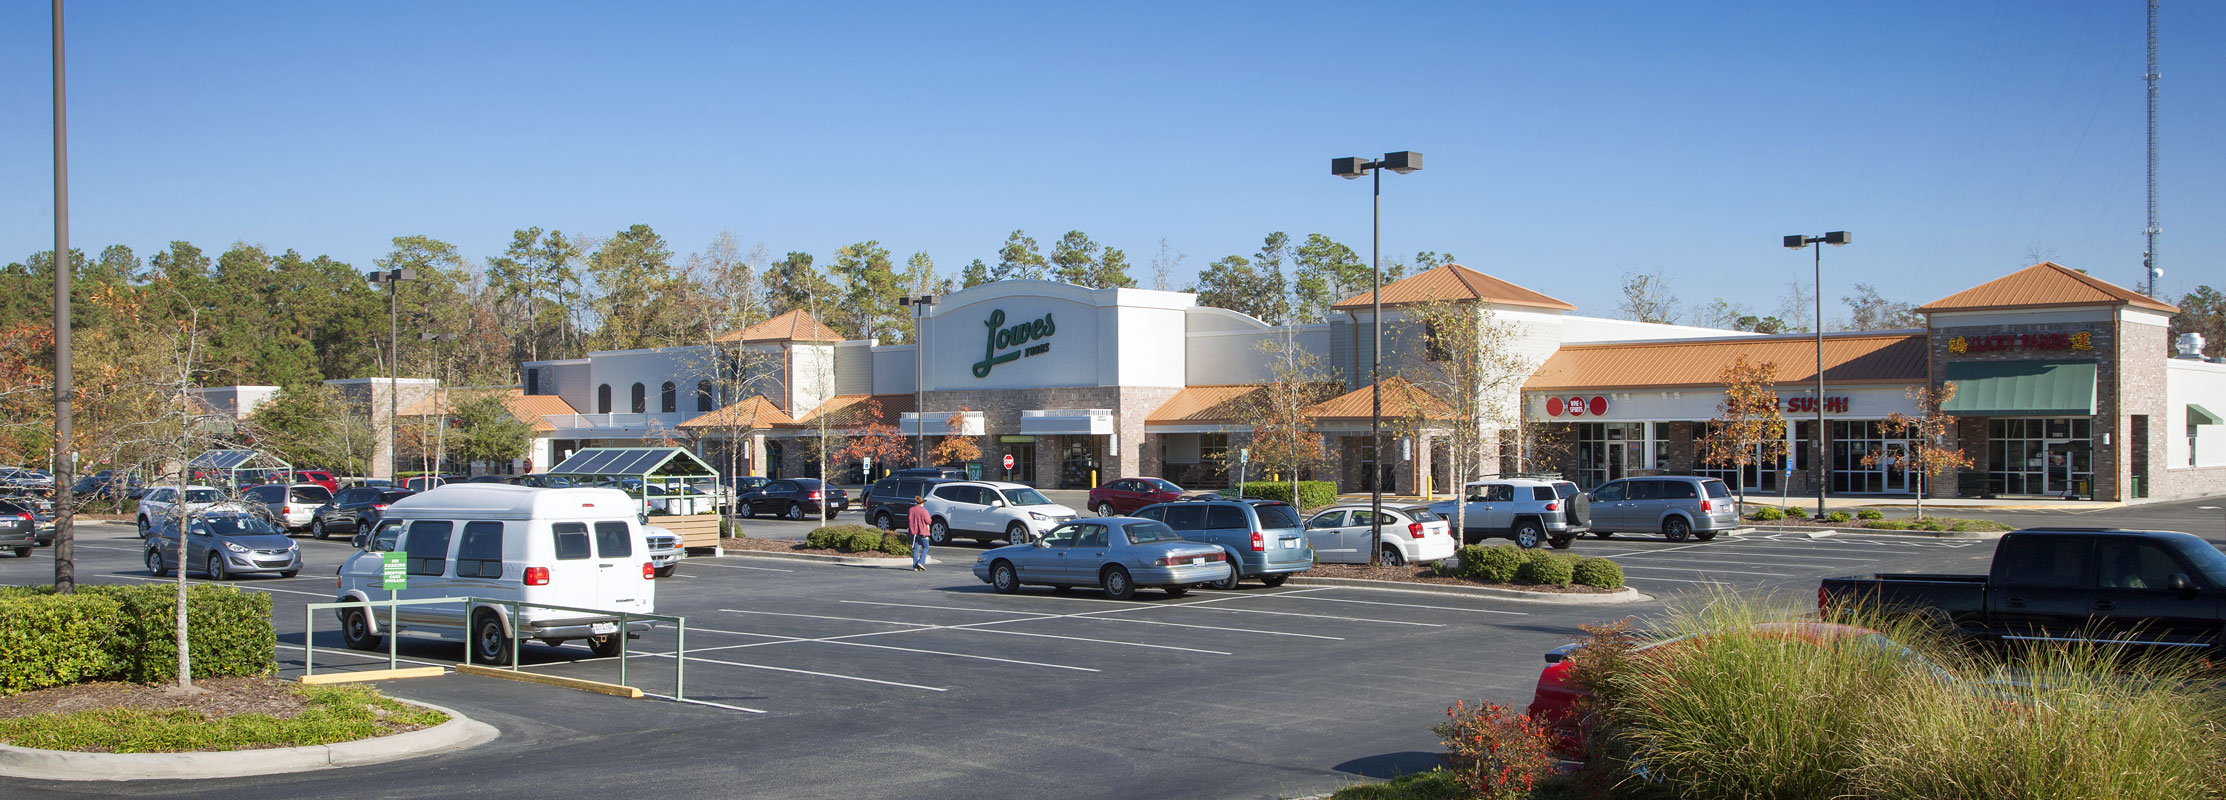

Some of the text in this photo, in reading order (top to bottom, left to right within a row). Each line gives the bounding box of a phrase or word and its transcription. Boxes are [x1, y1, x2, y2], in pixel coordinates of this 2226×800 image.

[972, 309, 1055, 378] Lowes
[1970, 332, 2072, 352] LUCKY PANDA
[1787, 396, 1848, 413] SUSHI
